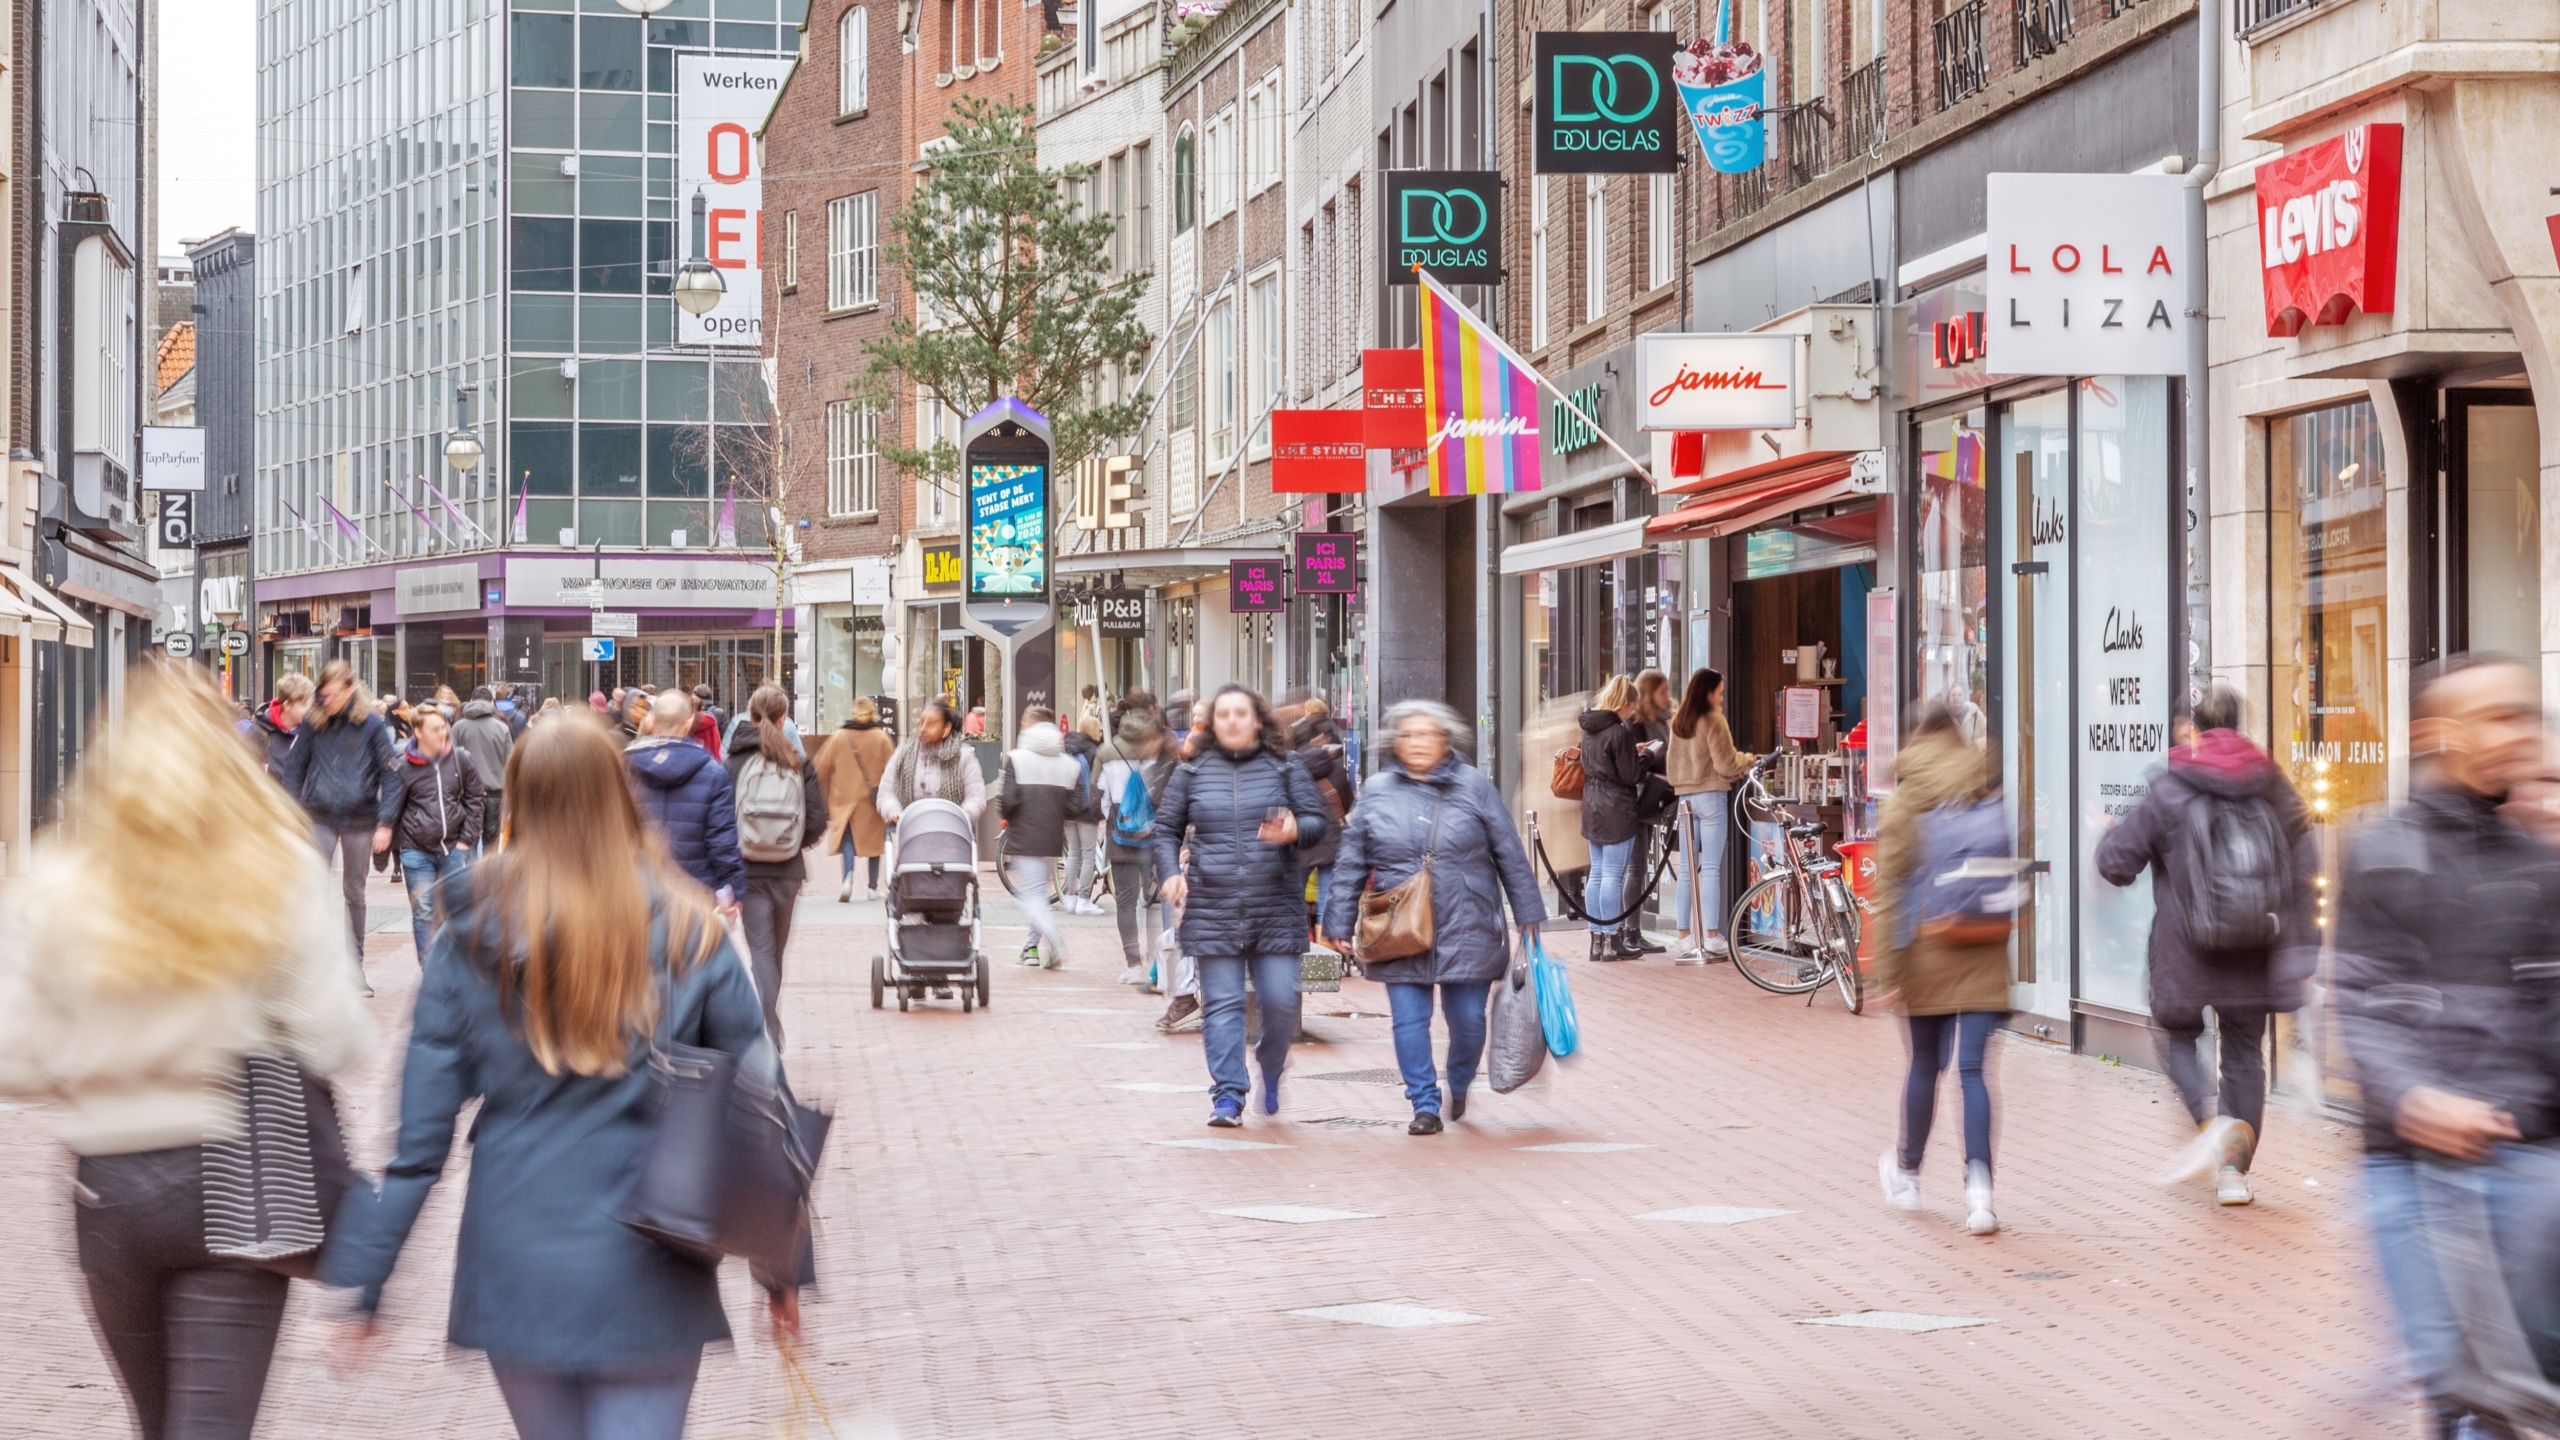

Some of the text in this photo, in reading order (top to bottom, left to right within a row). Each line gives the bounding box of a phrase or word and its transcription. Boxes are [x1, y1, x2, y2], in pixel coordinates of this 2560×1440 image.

[703, 72, 778, 90] Werken
[1553, 53, 1660, 124] DO
[1553, 129, 1660, 152] DOUGLAS
[1402, 188, 1488, 245] DO
[708, 208, 762, 270] E
[1402, 248, 1488, 267] DOUGLAS
[2010, 244, 2172, 274] LOLA
[2010, 298, 2172, 328] LIZA
[704, 317, 762, 337] open
[1650, 363, 1788, 407] jamin
[1371, 392, 1406, 404] THE
[1552, 382, 1599, 456] DOUGLAS
[1428, 410, 1538, 454] jamin
[1279, 446, 1360, 456] THE STING
[976, 484, 1024, 506] TENT OP DE
[1076, 455, 1144, 530] WE
[980, 492, 1035, 518] STADSE MERT
[2033, 494, 2064, 546] larks
[1017, 525, 1041, 541] 2020
[1316, 542, 1336, 555] ICI
[1306, 557, 1346, 570] PARIS
[1248, 568, 1265, 579] ICI
[1318, 572, 1335, 584] XL
[656, 578, 676, 590] OF
[681, 578, 767, 590] INNOVATION
[1240, 581, 1274, 591] PARIS
[1250, 593, 1265, 604] XL
[1103, 599, 1142, 618] P&B
[1103, 621, 1141, 629] PULL&BEAR
[2103, 606, 2143, 654] Clarks
[166, 641, 191, 649] ONLY
[222, 638, 246, 648] ONLY
[2109, 677, 2140, 706] WE'RE
[2089, 724, 2163, 752] NEARLY READY
[2291, 741, 2384, 763] BALLOON JEANS
[2101, 784, 2121, 796] DISCOVER
[2122, 785, 2127, 796] US
[2104, 804, 2113, 816] AND
[1857, 896, 1880, 914] Chup
